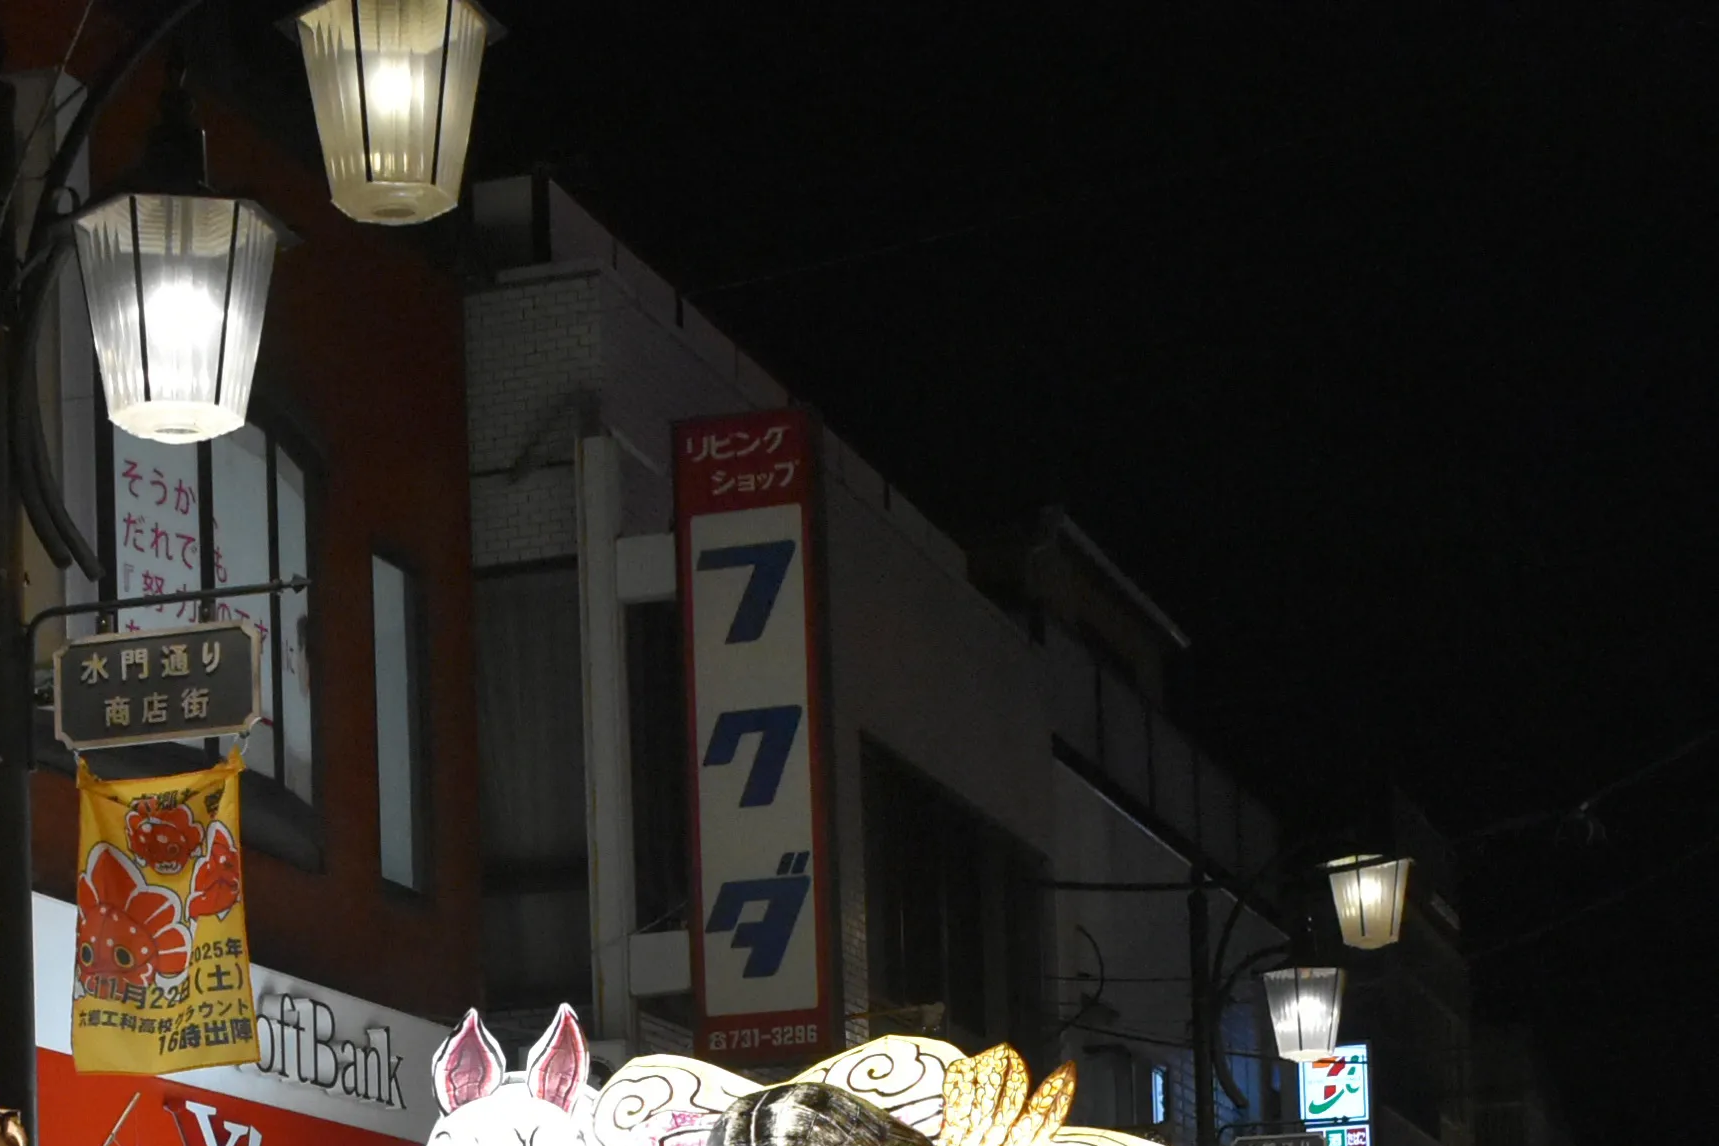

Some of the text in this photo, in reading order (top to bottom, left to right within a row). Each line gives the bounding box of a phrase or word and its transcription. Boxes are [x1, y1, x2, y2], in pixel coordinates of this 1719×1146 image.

[123, 511, 228, 584] だれでも
[80, 640, 222, 684] 水門通り
[104, 687, 211, 727] 商店街
[696, 539, 812, 978] フクダ
[158, 1017, 253, 1055] 16時出陣
[256, 992, 407, 1110] oftBank
[728, 1024, 818, 1049] 731-3296
